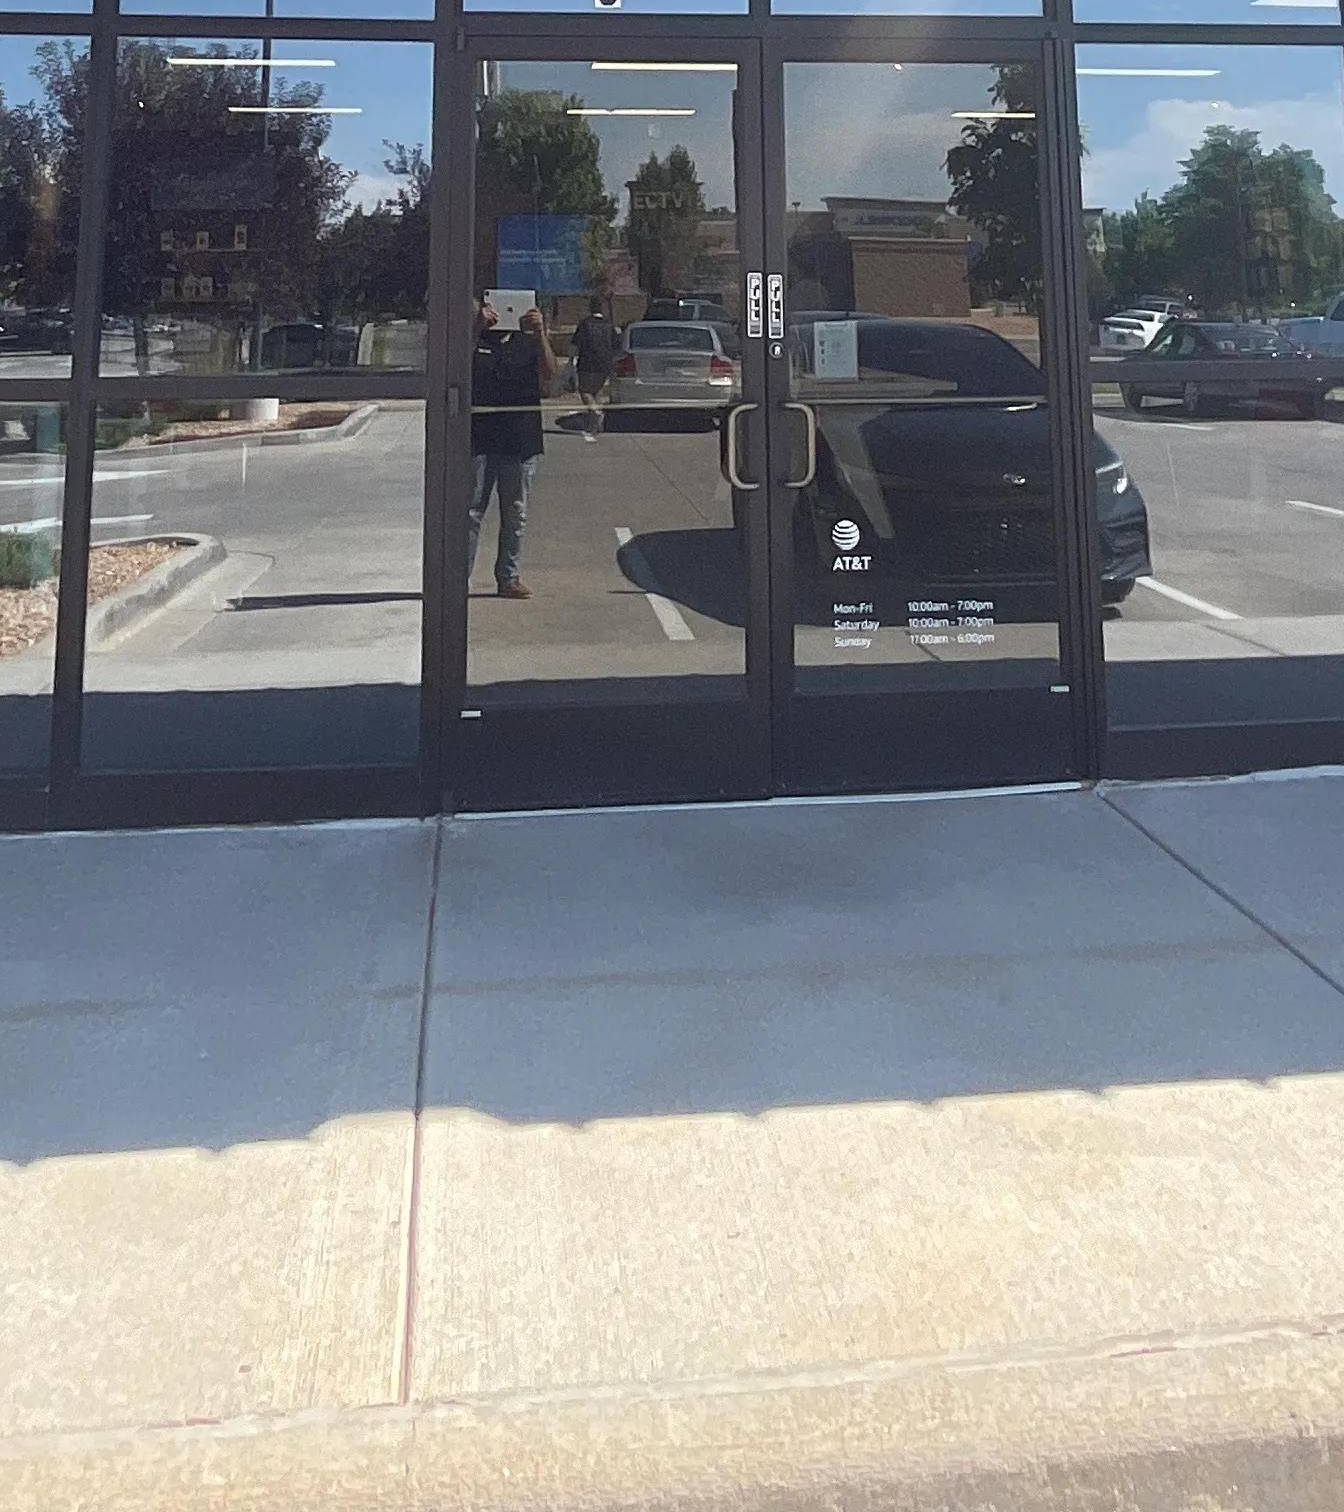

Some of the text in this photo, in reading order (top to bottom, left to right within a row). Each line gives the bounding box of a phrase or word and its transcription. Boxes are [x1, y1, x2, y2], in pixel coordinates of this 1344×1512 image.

[751, 278, 760, 321] PULL
[771, 280, 781, 323] PULL
[832, 556, 872, 572] AT&T
[834, 619, 880, 631] Saturday
